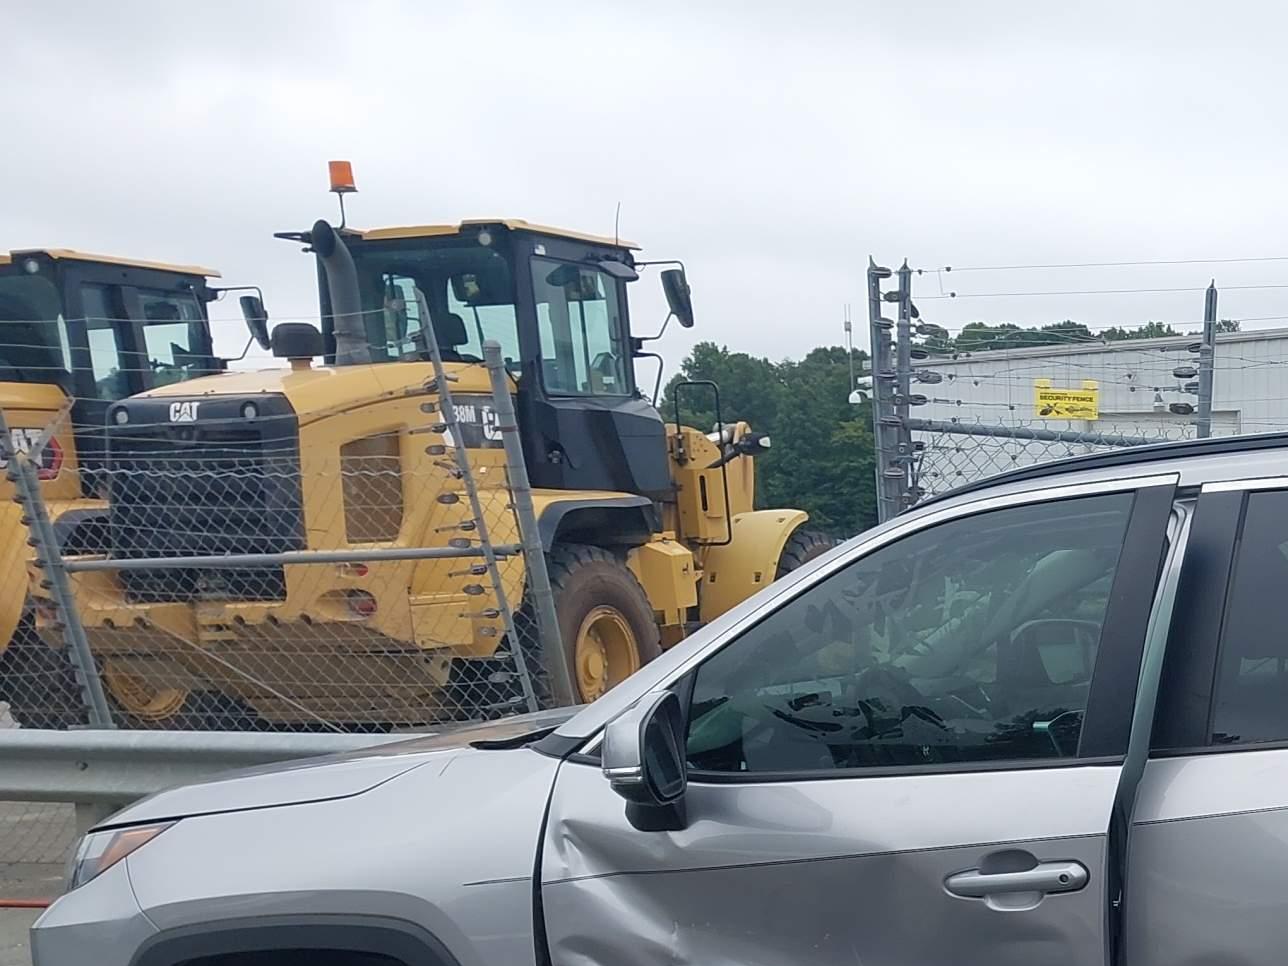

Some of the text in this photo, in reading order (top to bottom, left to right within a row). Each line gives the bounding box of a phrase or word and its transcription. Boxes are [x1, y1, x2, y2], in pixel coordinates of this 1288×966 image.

[1039, 394, 1072, 402] SECURITY
[169, 401, 201, 422] CAT
[450, 405, 477, 423] 38M
